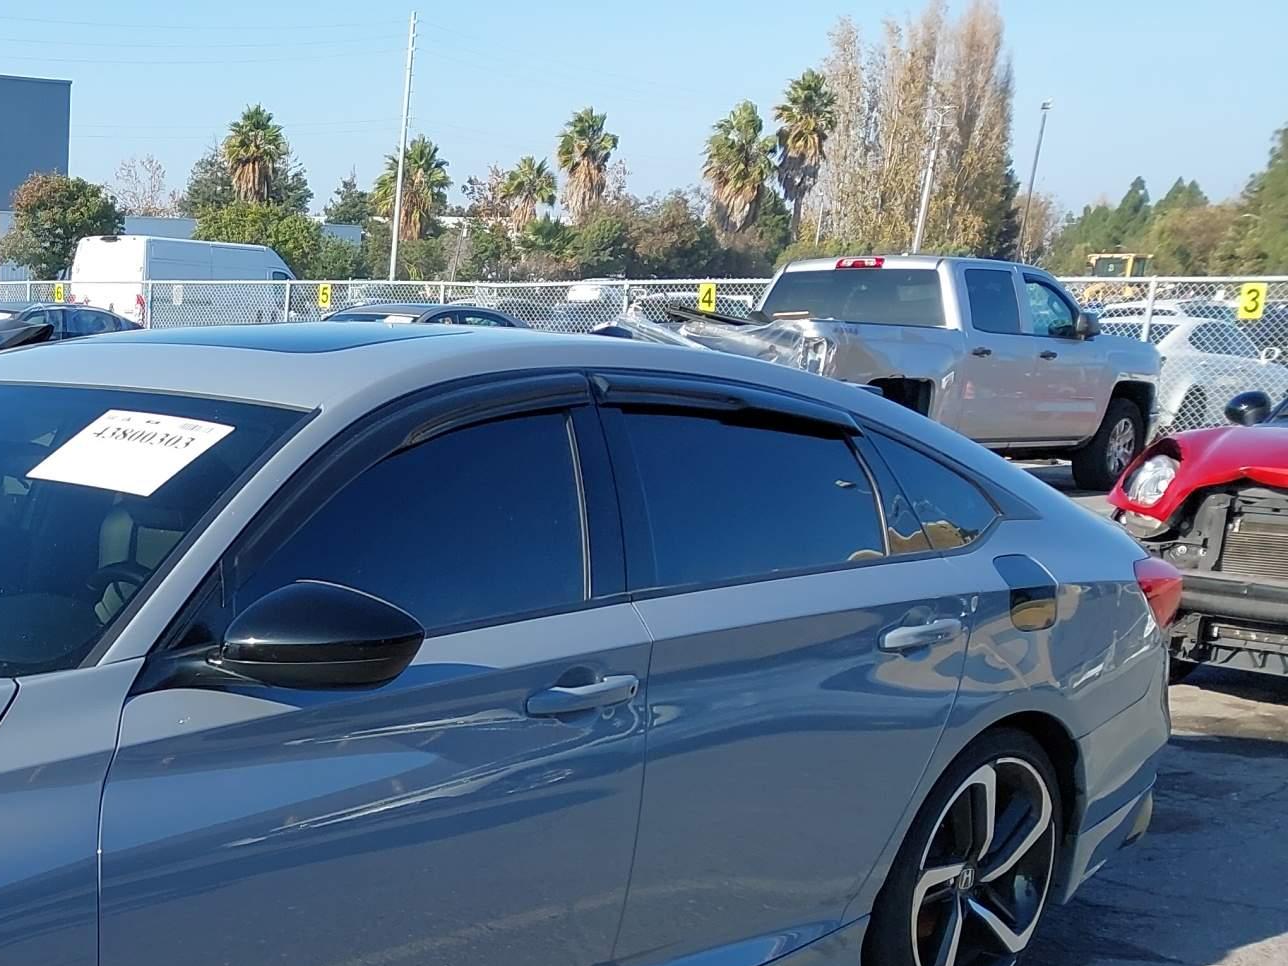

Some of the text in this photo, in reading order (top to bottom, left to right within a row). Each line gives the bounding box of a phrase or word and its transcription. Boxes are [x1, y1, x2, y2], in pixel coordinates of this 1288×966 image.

[56, 286, 62, 300] 6
[321, 286, 329, 304] 5
[701, 287, 713, 308] 4
[1244, 288, 1260, 313] 3
[93, 426, 195, 449] 43800303
